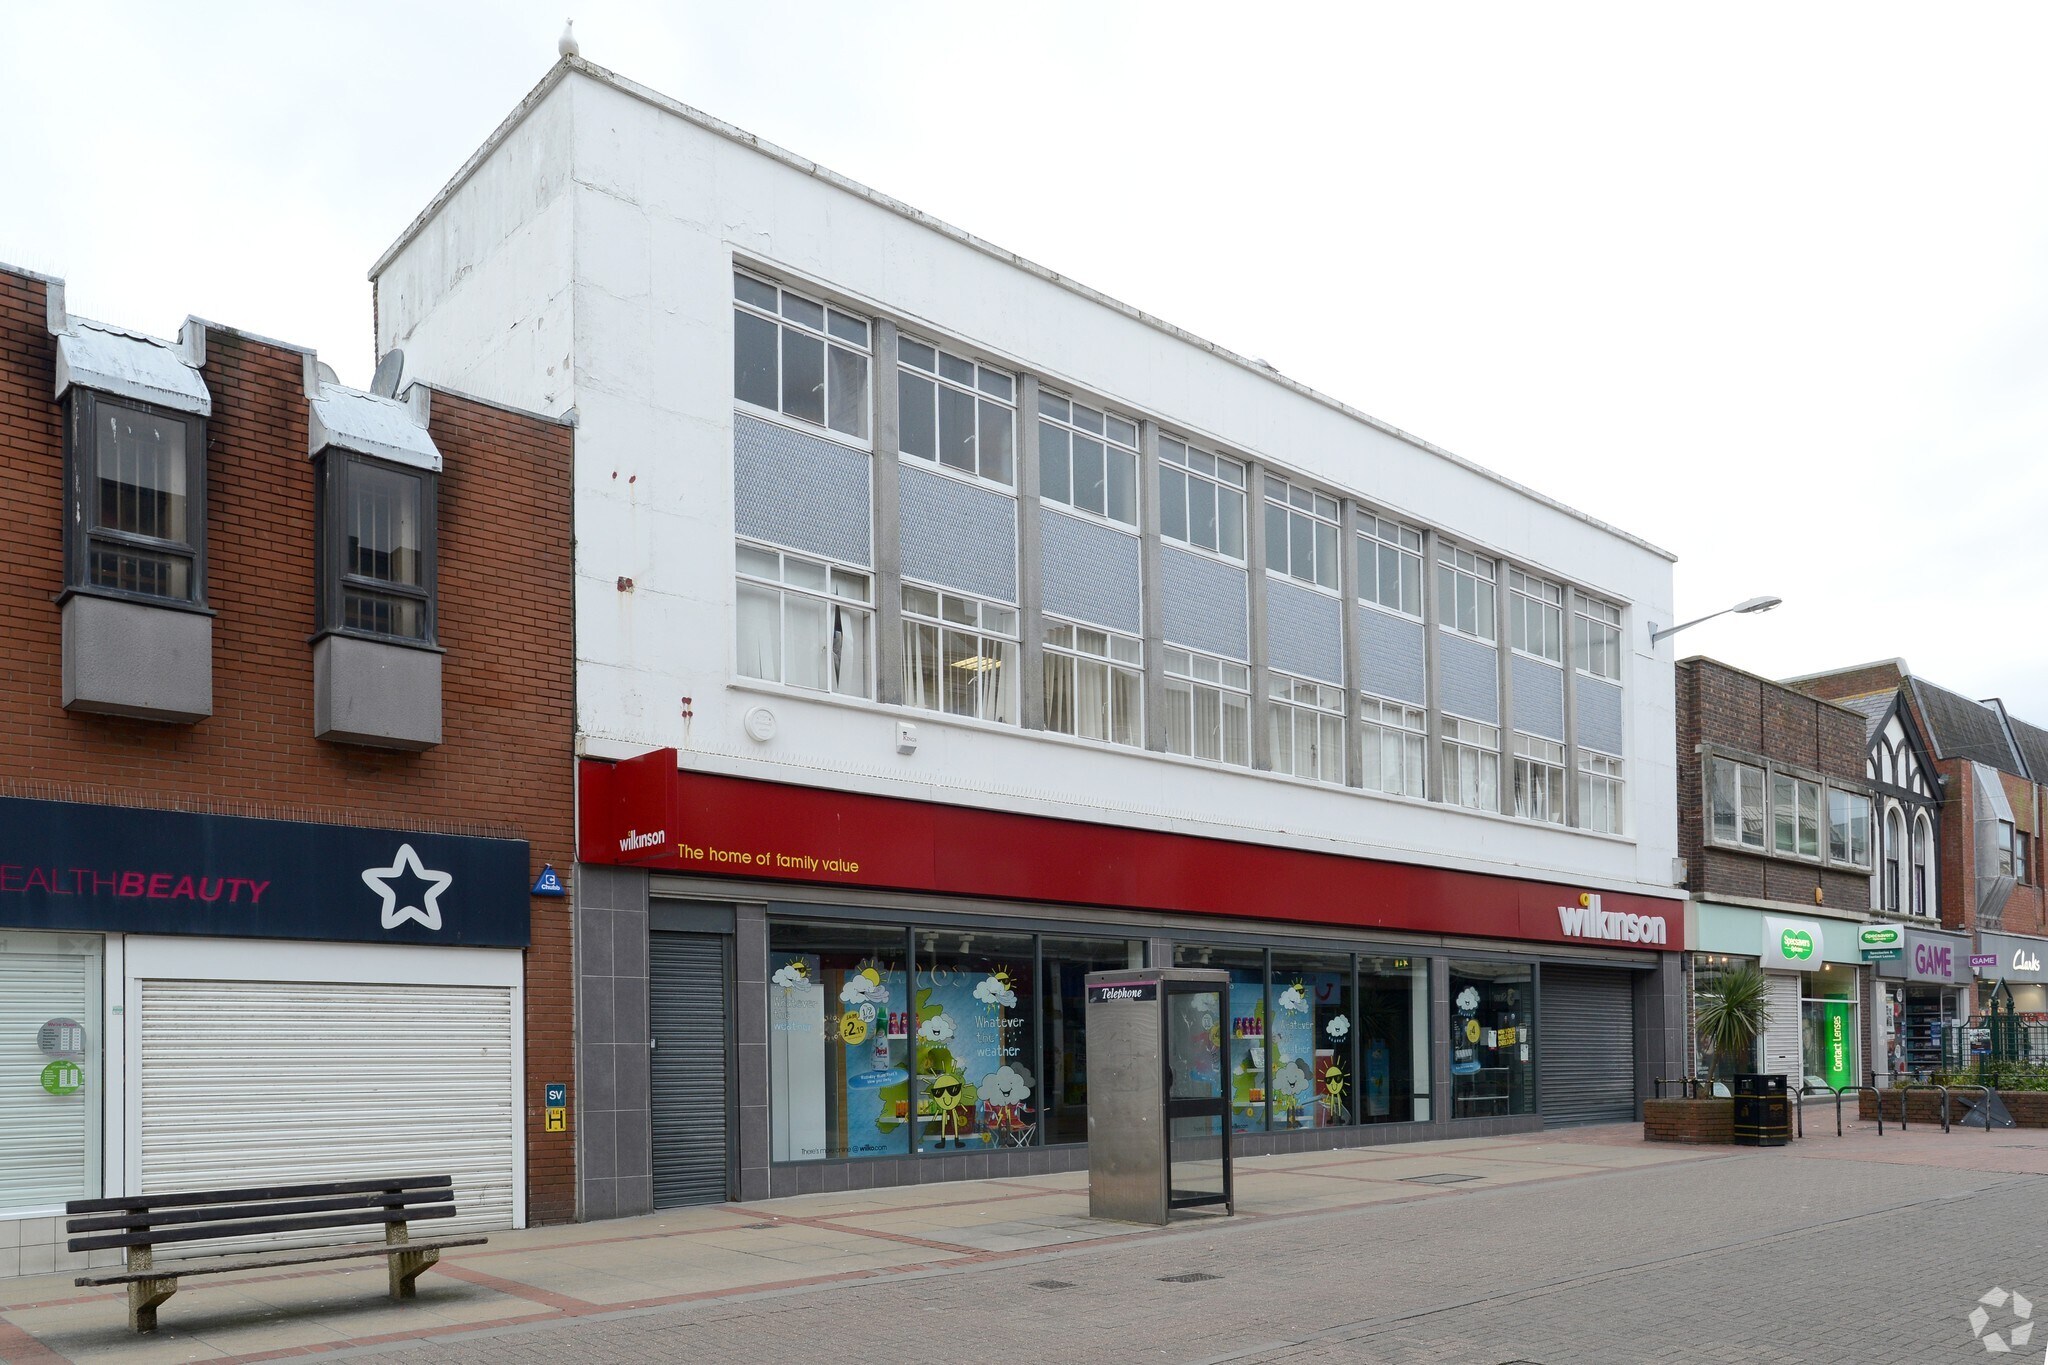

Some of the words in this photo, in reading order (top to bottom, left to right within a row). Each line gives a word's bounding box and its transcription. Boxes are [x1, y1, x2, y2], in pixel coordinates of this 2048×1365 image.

[619, 829, 666, 852] wilkinson
[678, 843, 704, 859] The
[709, 847, 752, 864] home
[756, 852, 771, 866] of
[776, 853, 819, 872] family
[822, 859, 859, 873] value
[1557, 892, 1667, 945] wilkinson
[1783, 935, 1811, 947] Specsavers
[1915, 943, 1952, 977] GAME
[1971, 957, 1995, 965] GAME
[2012, 948, 2041, 972] Clarks
[1101, 987, 1142, 999] Telephone
[974, 1015, 1024, 1028] Whatever
[1832, 1015, 1842, 1041] Lenses
[976, 1032, 995, 1043] the
[976, 1044, 1021, 1057] weather
[1833, 1043, 1843, 1072] Contact
[549, 1090, 563, 1100] SV
[549, 1110, 563, 1129] H
